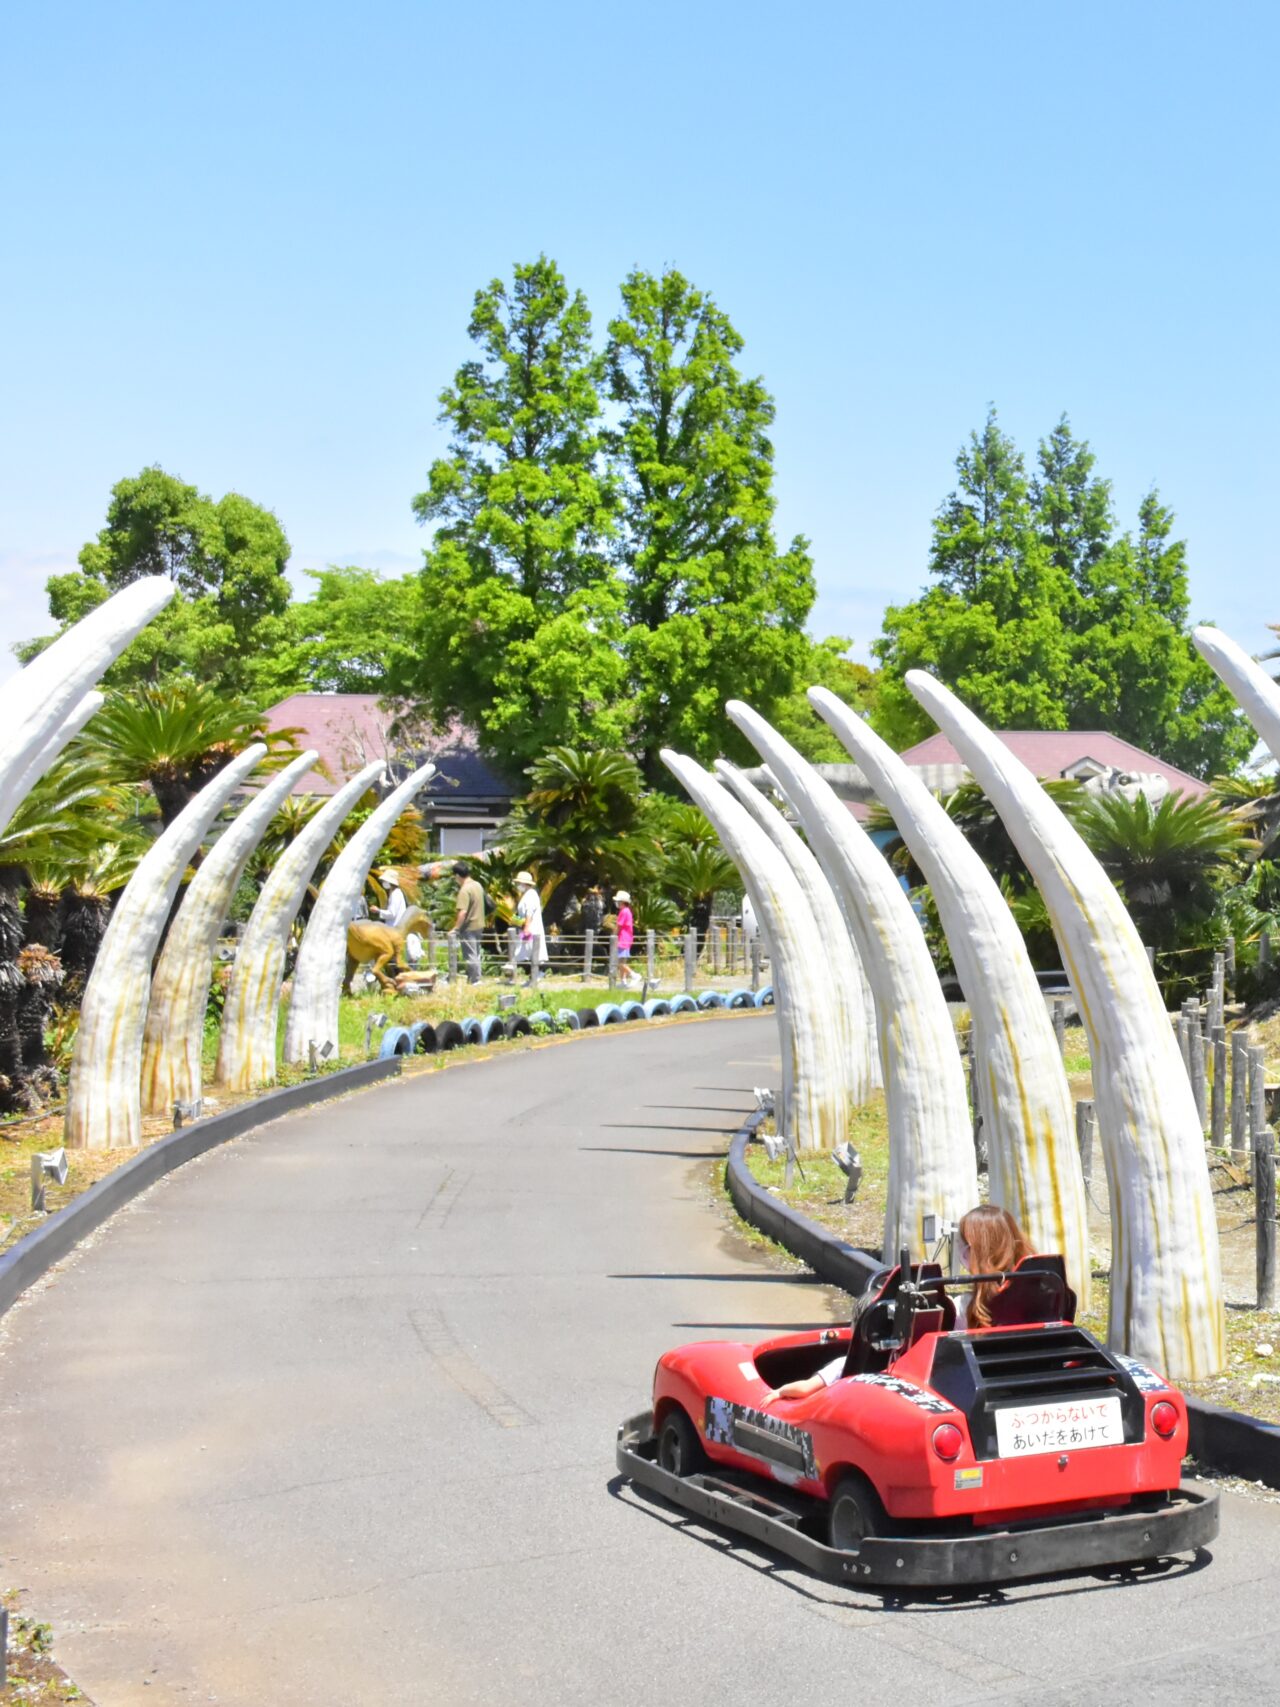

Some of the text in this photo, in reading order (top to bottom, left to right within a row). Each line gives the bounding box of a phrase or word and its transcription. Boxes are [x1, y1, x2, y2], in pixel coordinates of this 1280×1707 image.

[1013, 1425, 1109, 1450] あいだをあけて
